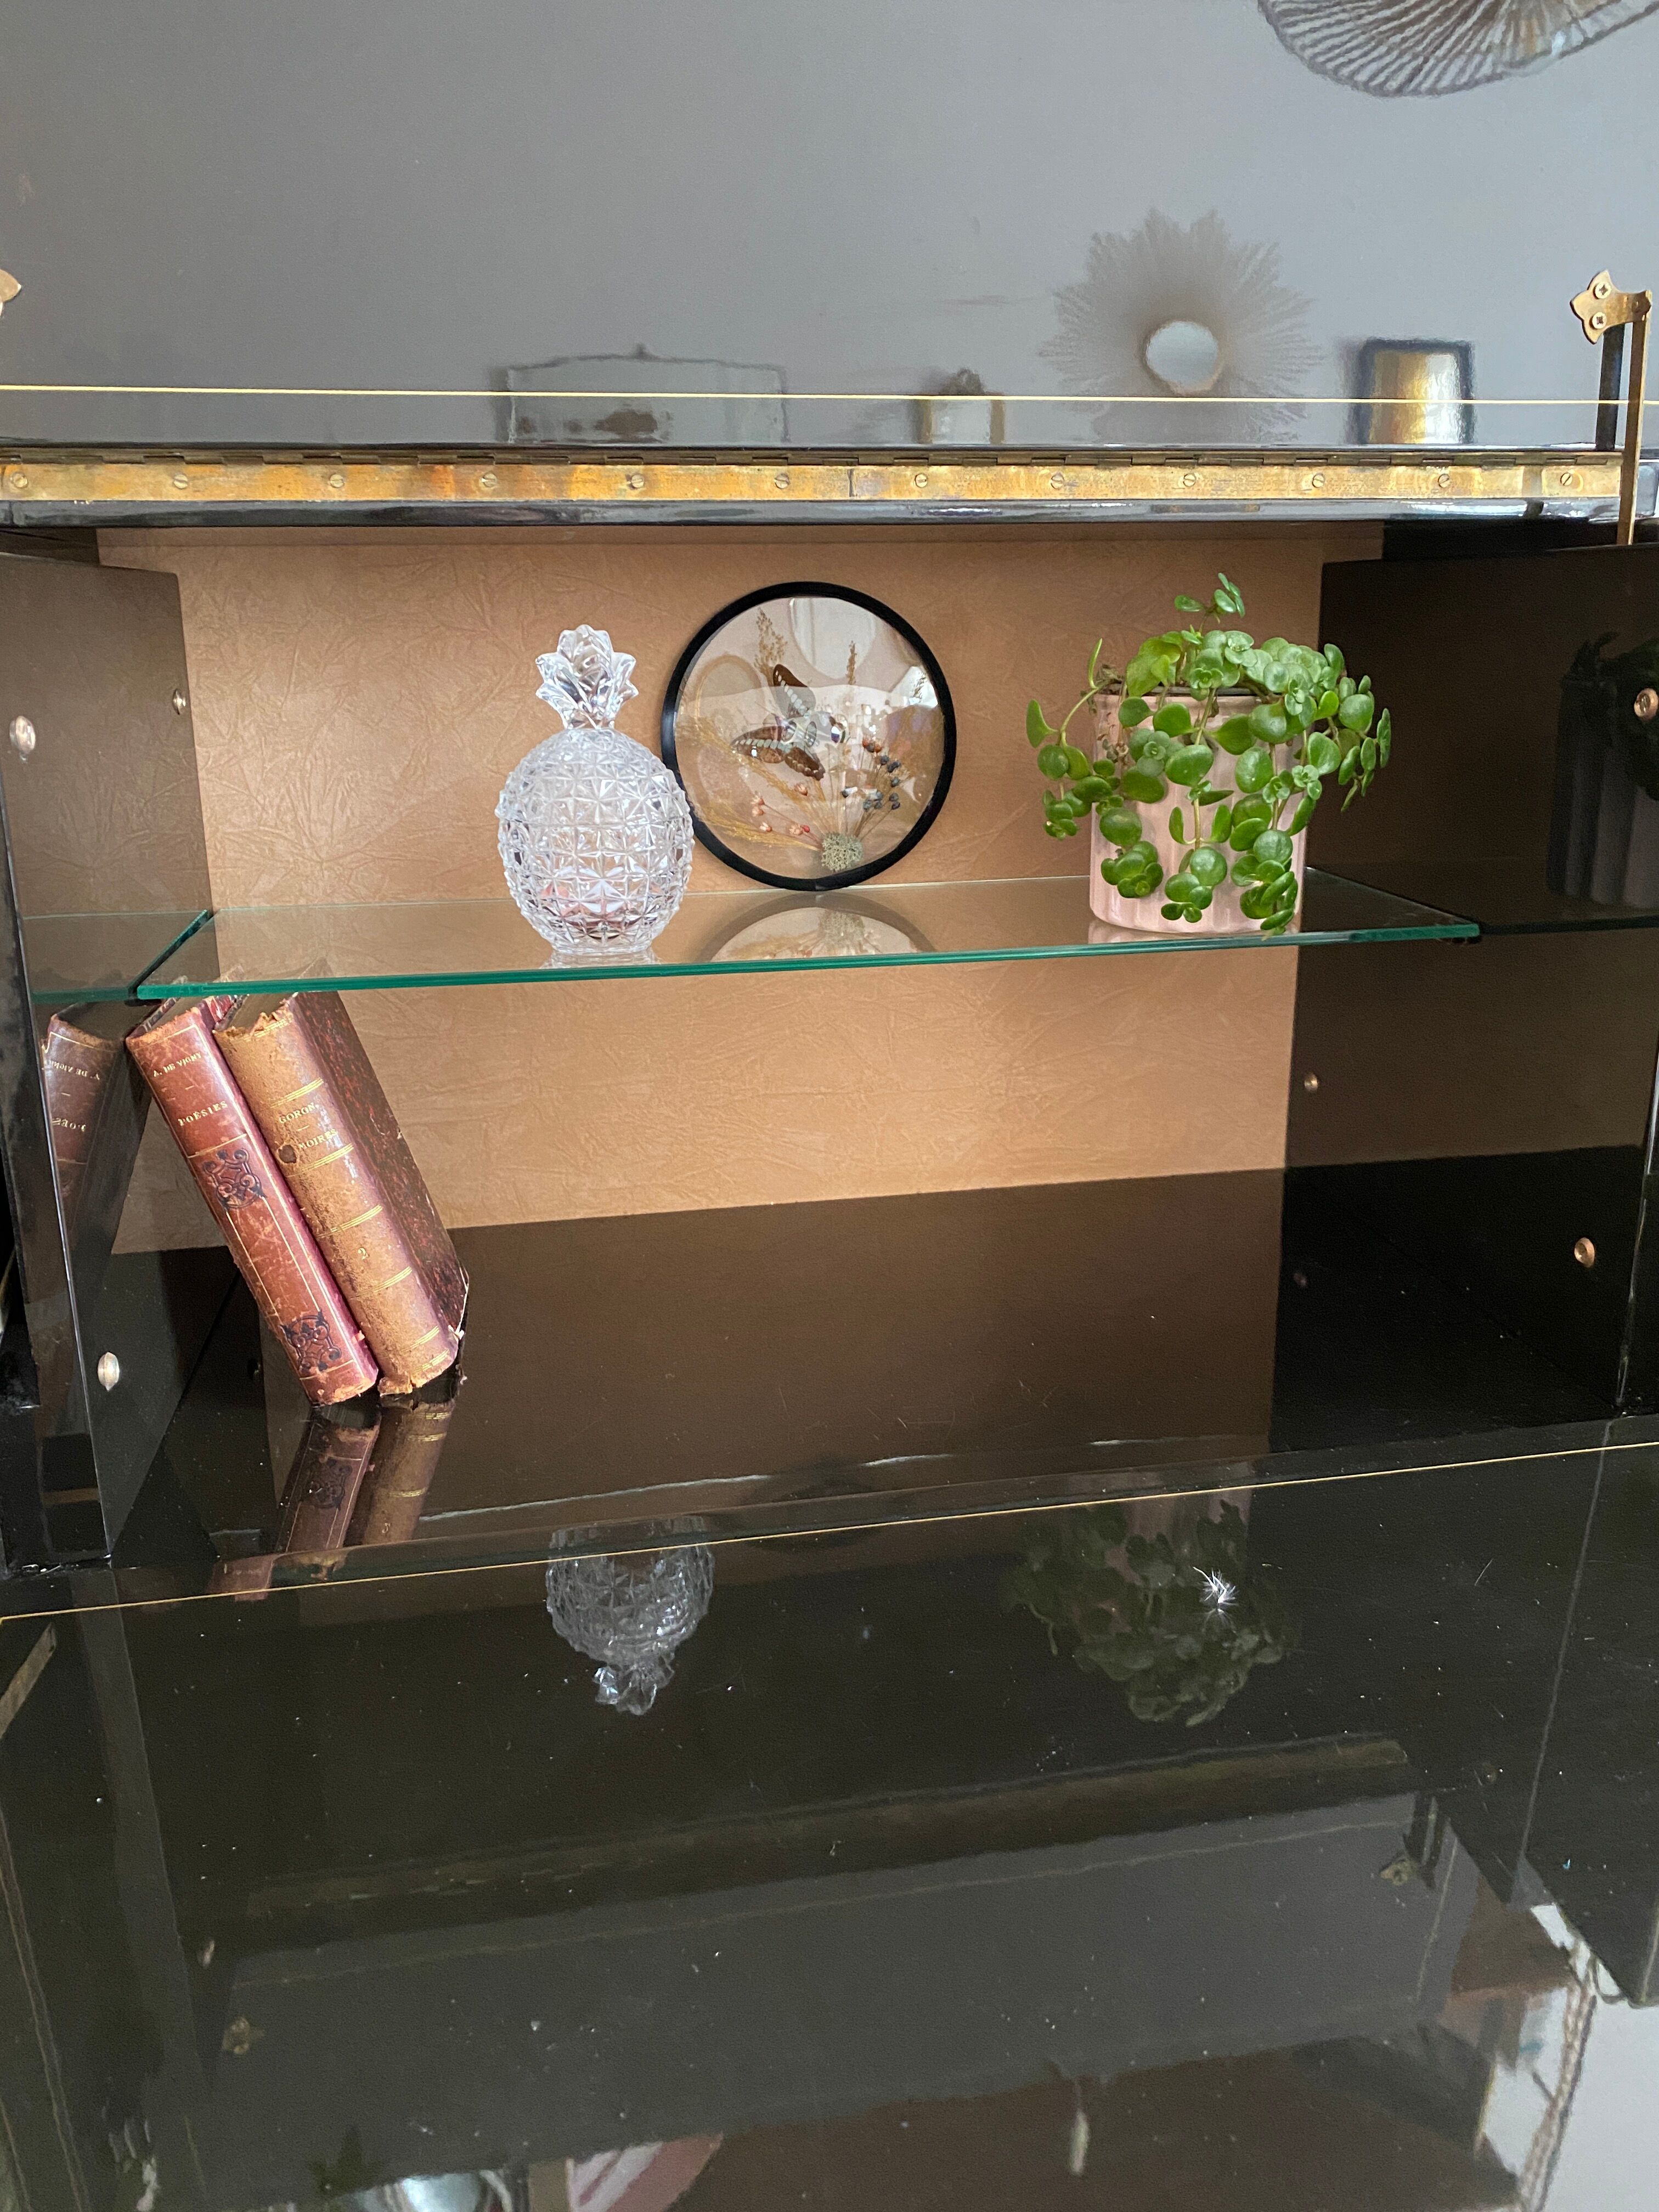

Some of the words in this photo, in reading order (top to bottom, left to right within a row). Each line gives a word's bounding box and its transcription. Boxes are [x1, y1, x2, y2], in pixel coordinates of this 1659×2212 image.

[162, 1063, 176, 1074] DE
[176, 1052, 202, 1067] VIGNY
[358, 1248, 368, 1260] 2
